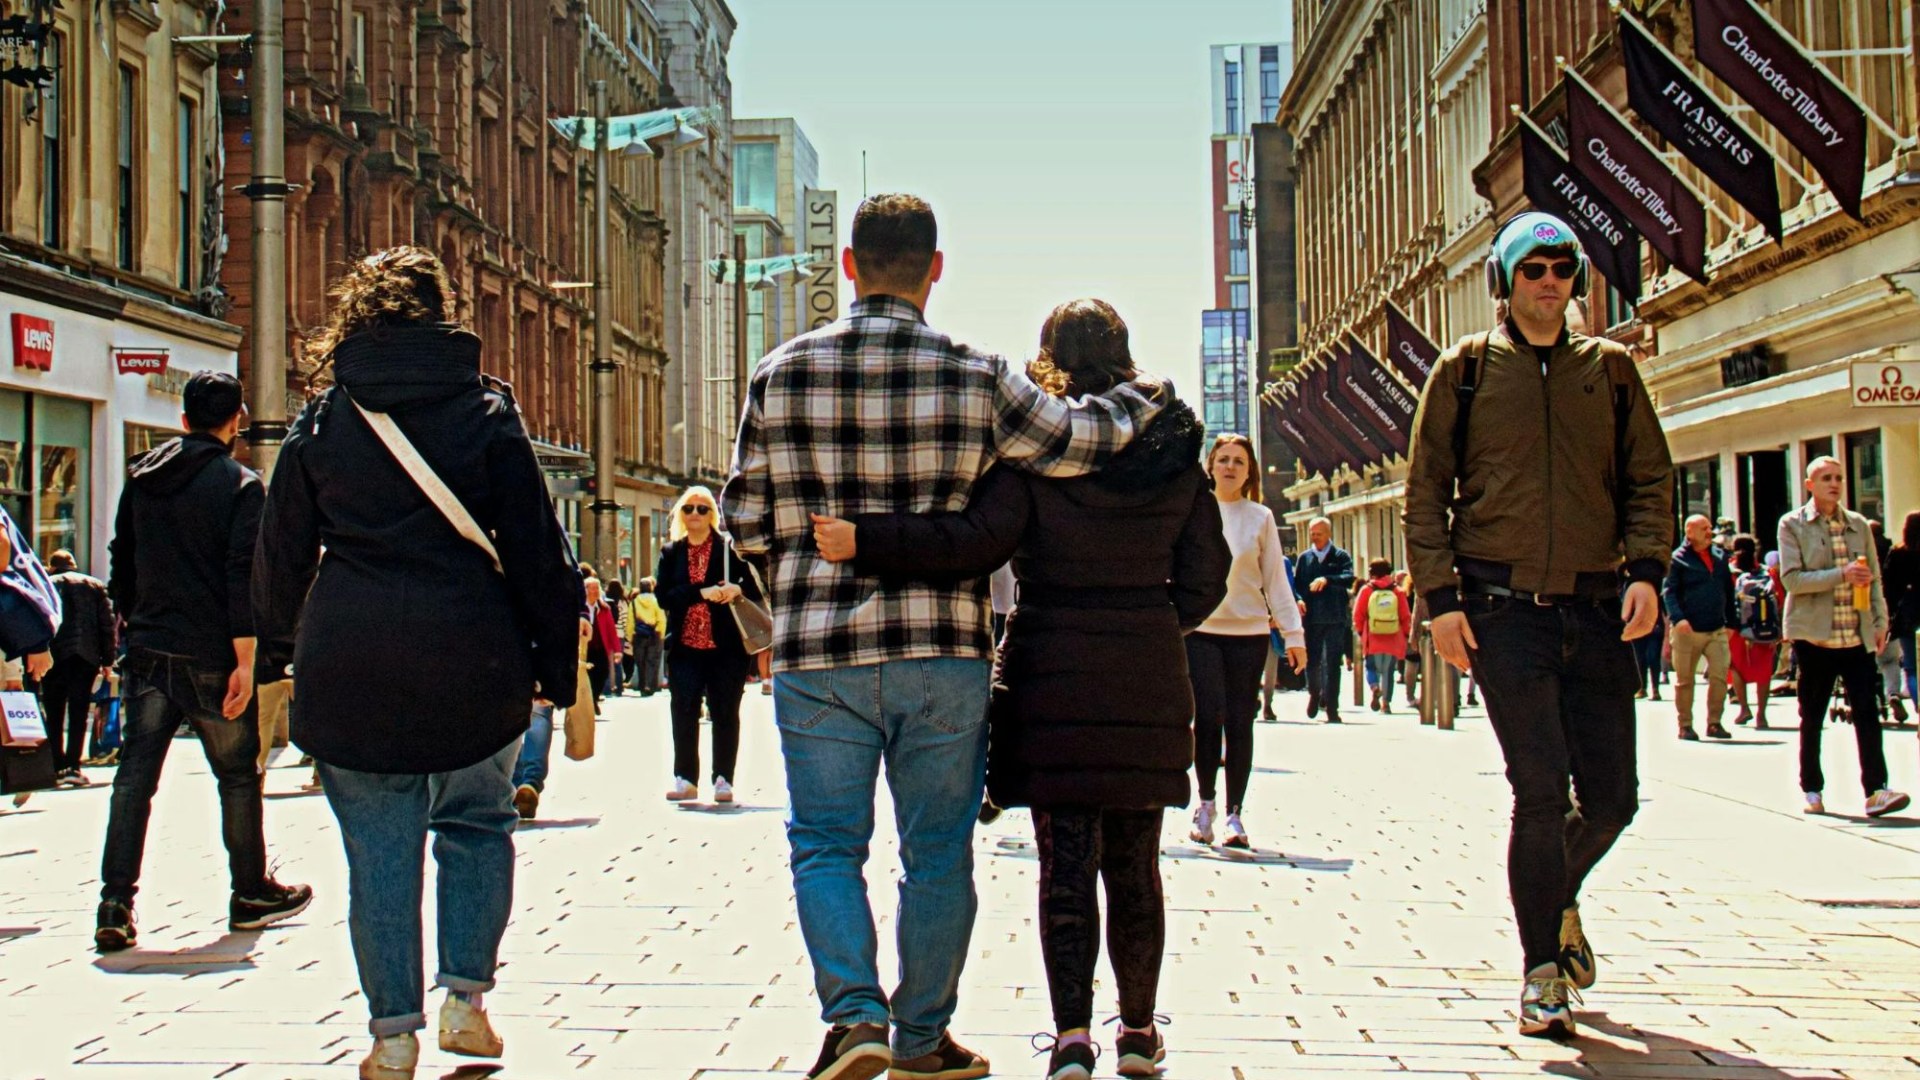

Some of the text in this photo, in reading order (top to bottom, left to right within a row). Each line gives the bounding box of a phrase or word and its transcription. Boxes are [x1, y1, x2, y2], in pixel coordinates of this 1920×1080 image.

[1661, 80, 1754, 166] FRASERS
[810, 201, 834, 235] ST
[1551, 173, 1624, 247] FRASERS
[1370, 367, 1415, 415] FRASERS
[7, 710, 38, 719] BOSS
